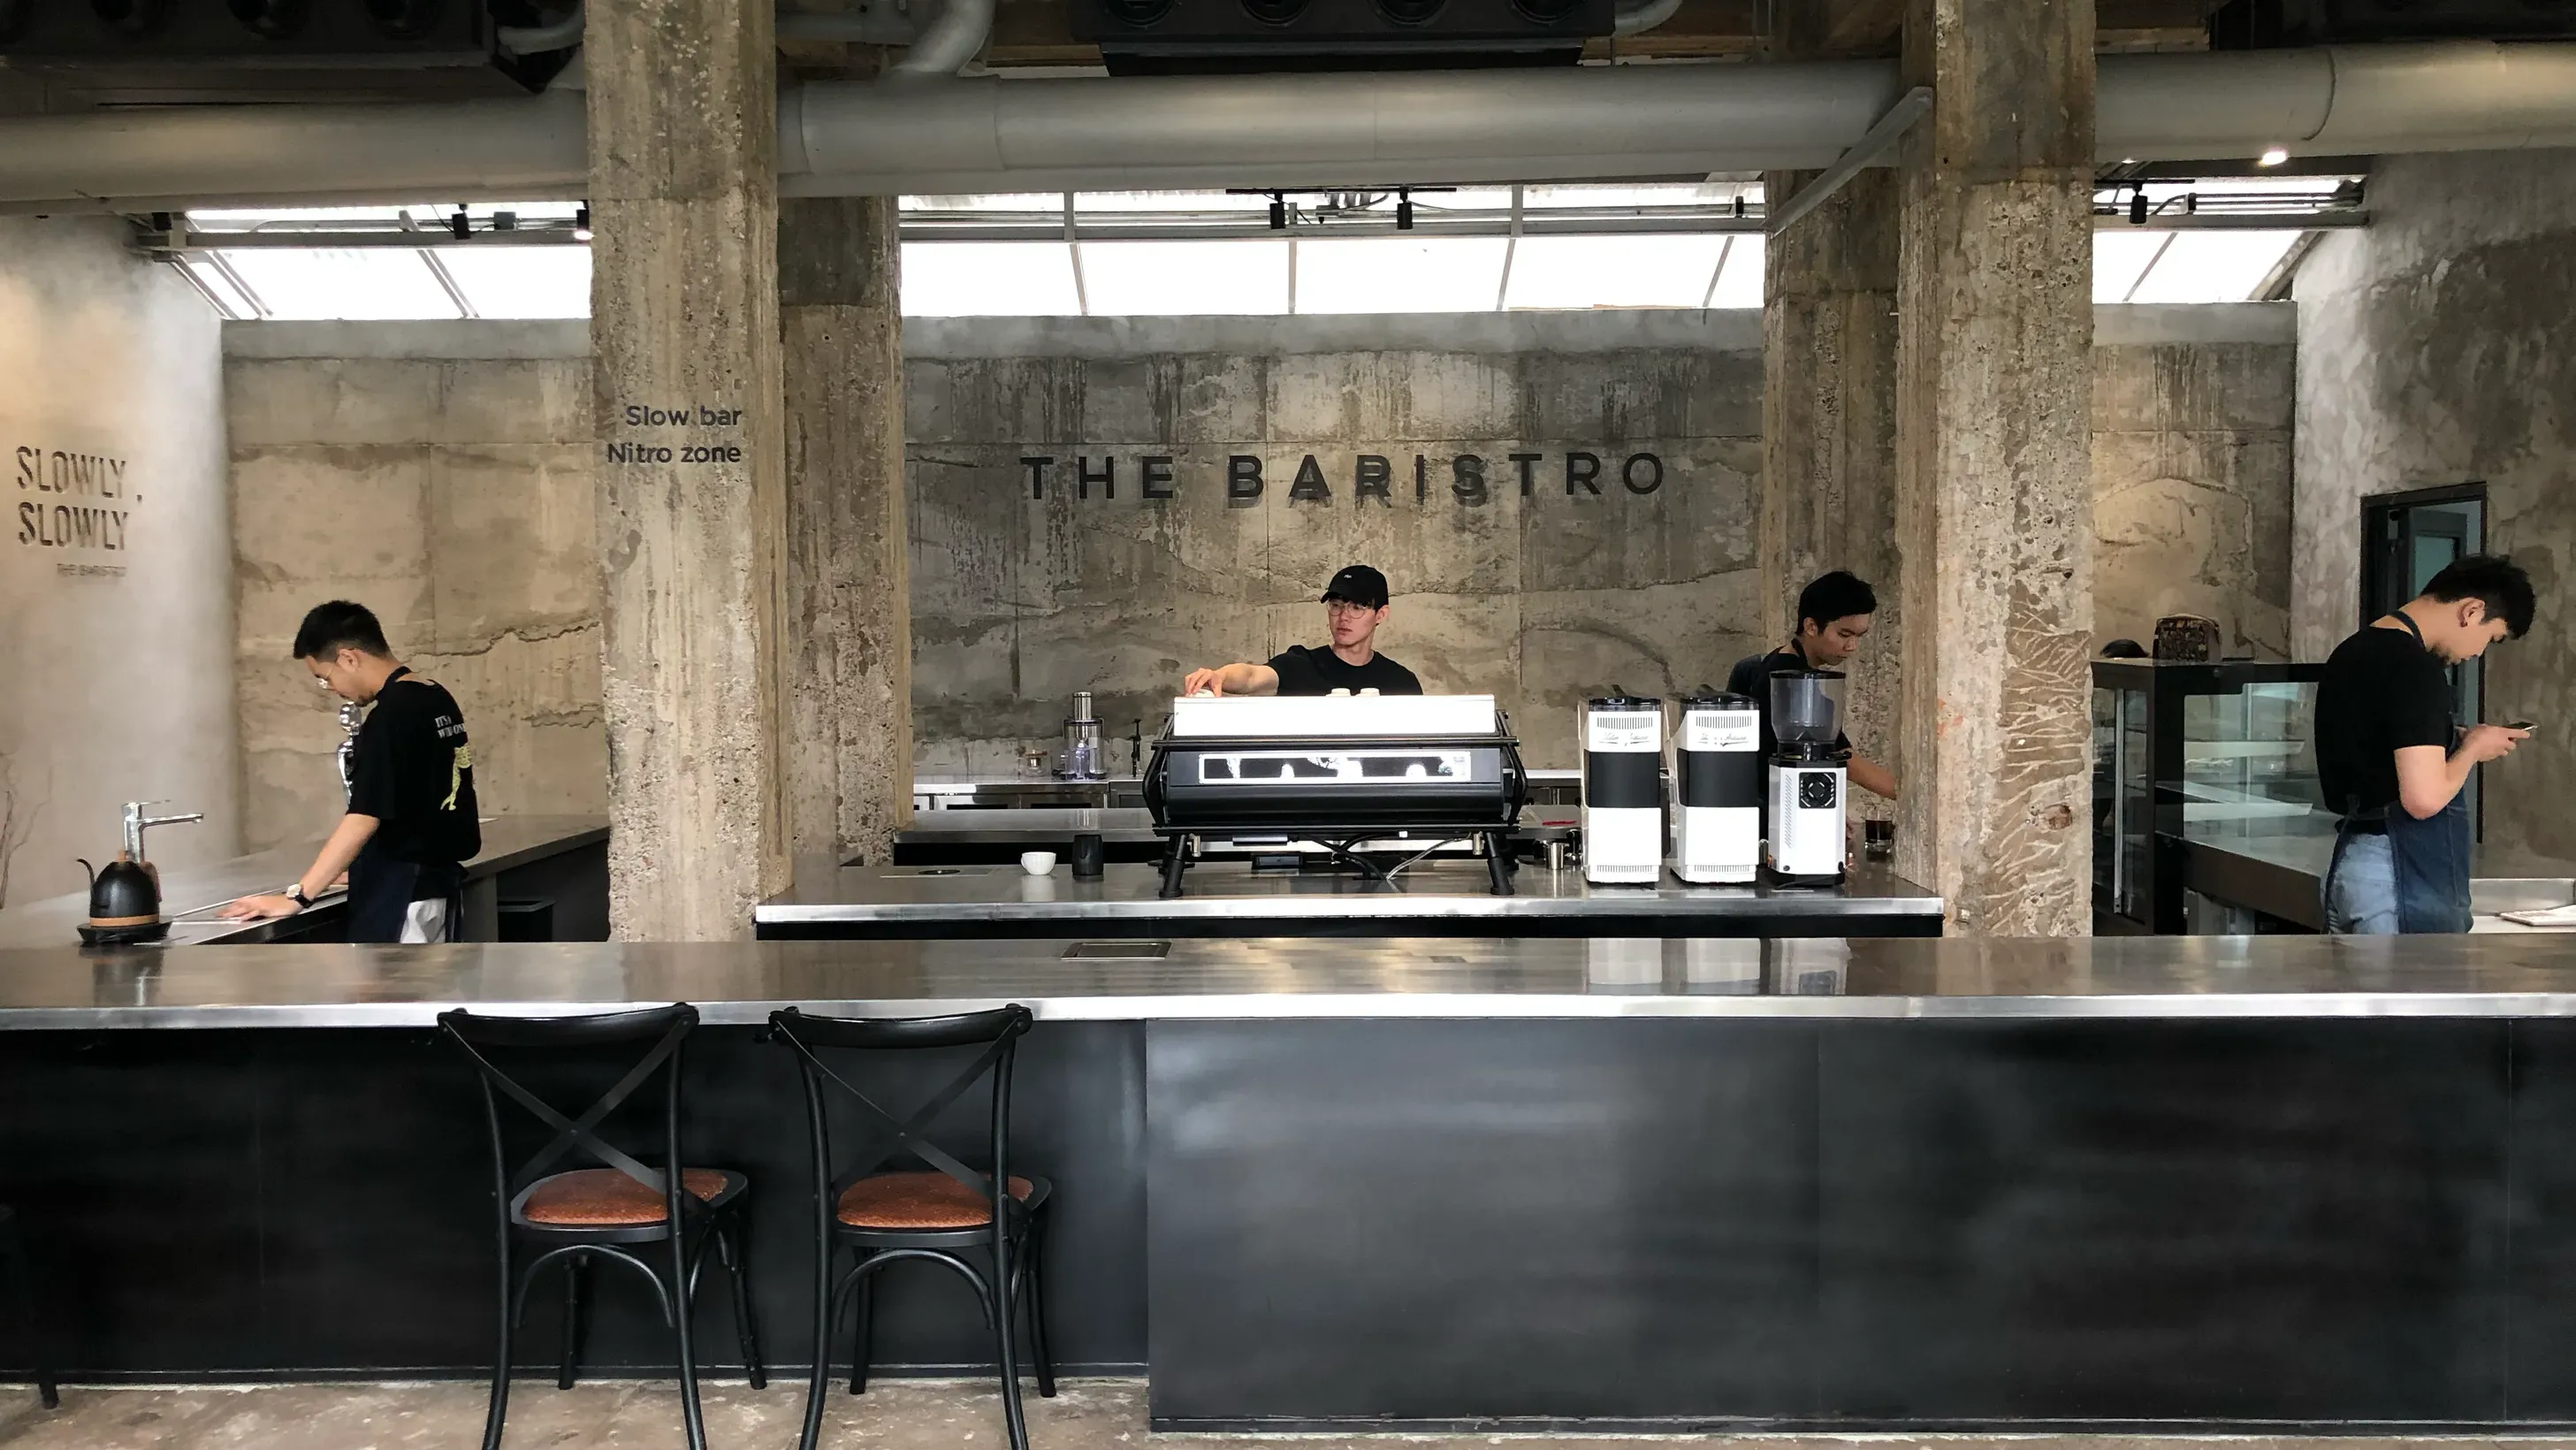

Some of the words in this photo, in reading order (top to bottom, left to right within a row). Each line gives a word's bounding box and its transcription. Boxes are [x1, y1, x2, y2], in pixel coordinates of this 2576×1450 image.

[626, 406, 690, 426] Slow
[700, 405, 743, 426] bar
[608, 442, 672, 463] Nitro
[681, 446, 741, 463] zone
[1020, 455, 1174, 500] THE
[1228, 452, 1664, 500] BARISTRO
[18, 501, 129, 551] SLOWLY
